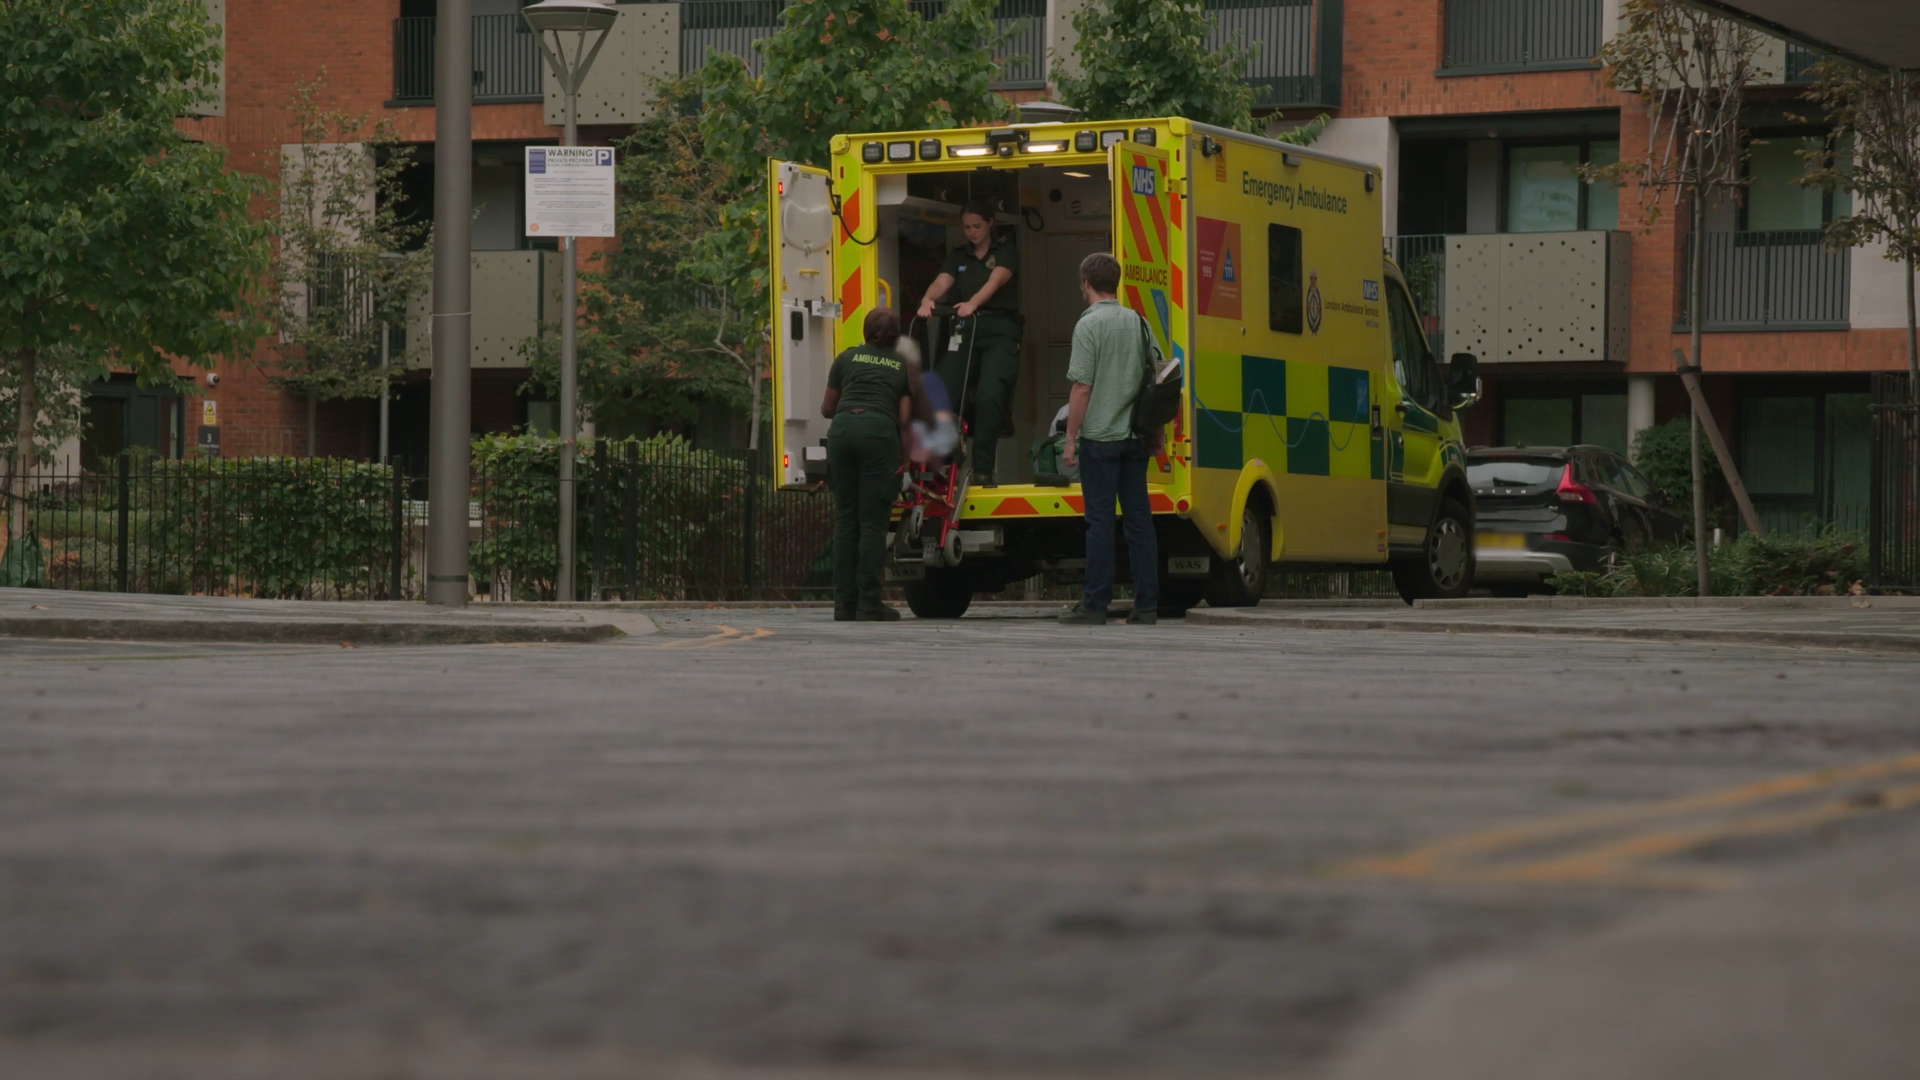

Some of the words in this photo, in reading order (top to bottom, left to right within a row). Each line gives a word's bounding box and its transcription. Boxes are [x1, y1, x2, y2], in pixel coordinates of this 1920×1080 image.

[548, 149, 593, 157] WARNING
[598, 151, 609, 165] P
[1133, 167, 1154, 195] NHS
[1242, 170, 1295, 210] Emergency
[1297, 182, 1348, 214] Ambulance
[1125, 263, 1168, 286] AMBULANCE
[1202, 265, 1212, 278] 999
[1224, 265, 1233, 279] 111
[1363, 280, 1378, 300] NHS
[1324, 298, 1340, 311] London
[1341, 301, 1364, 315] Ambulance
[1364, 304, 1379, 317] Service
[852, 353, 901, 370] AMBULANCE
[207, 433, 212, 443] 3
[1174, 561, 1202, 570] WAS
